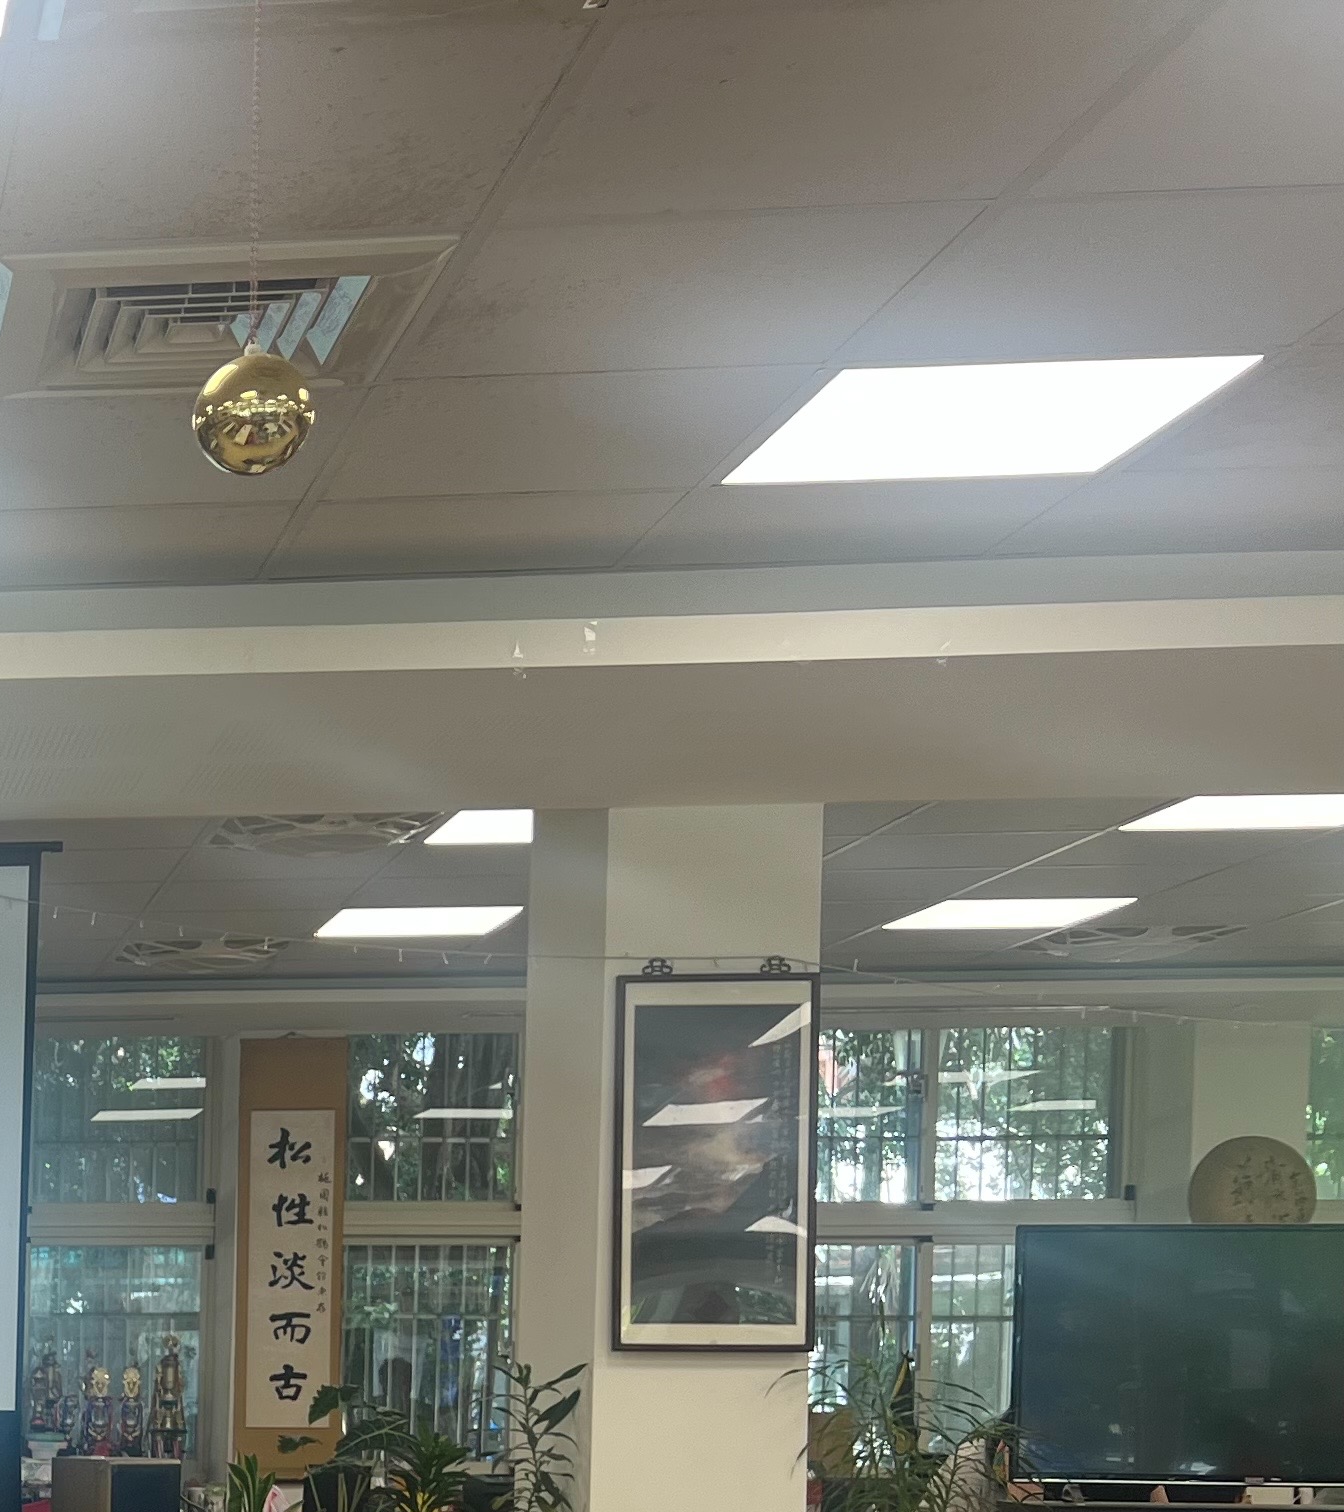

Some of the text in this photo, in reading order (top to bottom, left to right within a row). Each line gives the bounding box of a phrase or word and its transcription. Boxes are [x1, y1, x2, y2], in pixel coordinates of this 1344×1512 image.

[267, 1126, 316, 1402] 松性淡而古
